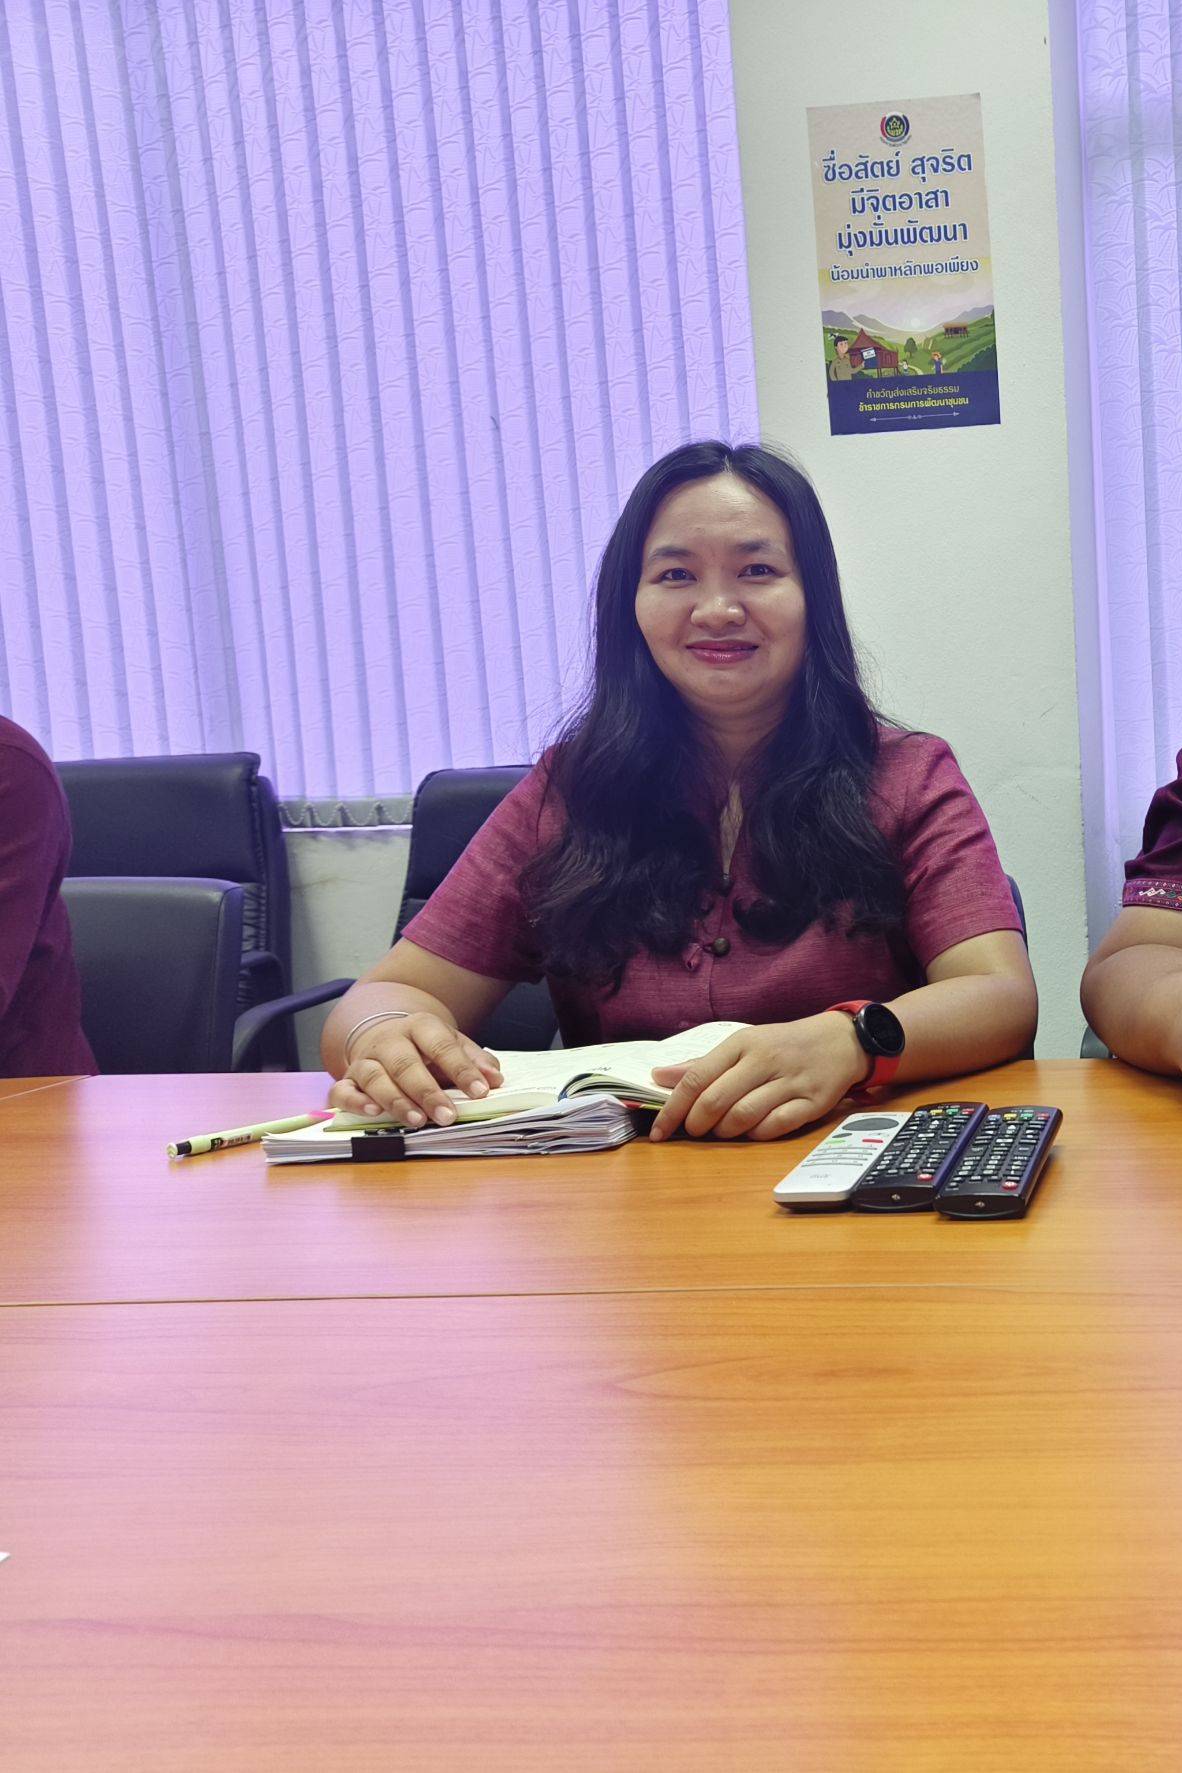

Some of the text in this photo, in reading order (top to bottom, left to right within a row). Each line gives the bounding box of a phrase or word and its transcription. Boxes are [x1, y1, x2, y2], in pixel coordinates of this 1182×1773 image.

[822, 148, 972, 182] ซื่อสัตย์ สุจริต
[851, 188, 950, 215] มีจิตอาสา
[838, 215, 968, 256] มุ่งมั่นพัฒนา
[831, 256, 979, 281] น้อมนำพาหลักพอเพียง
